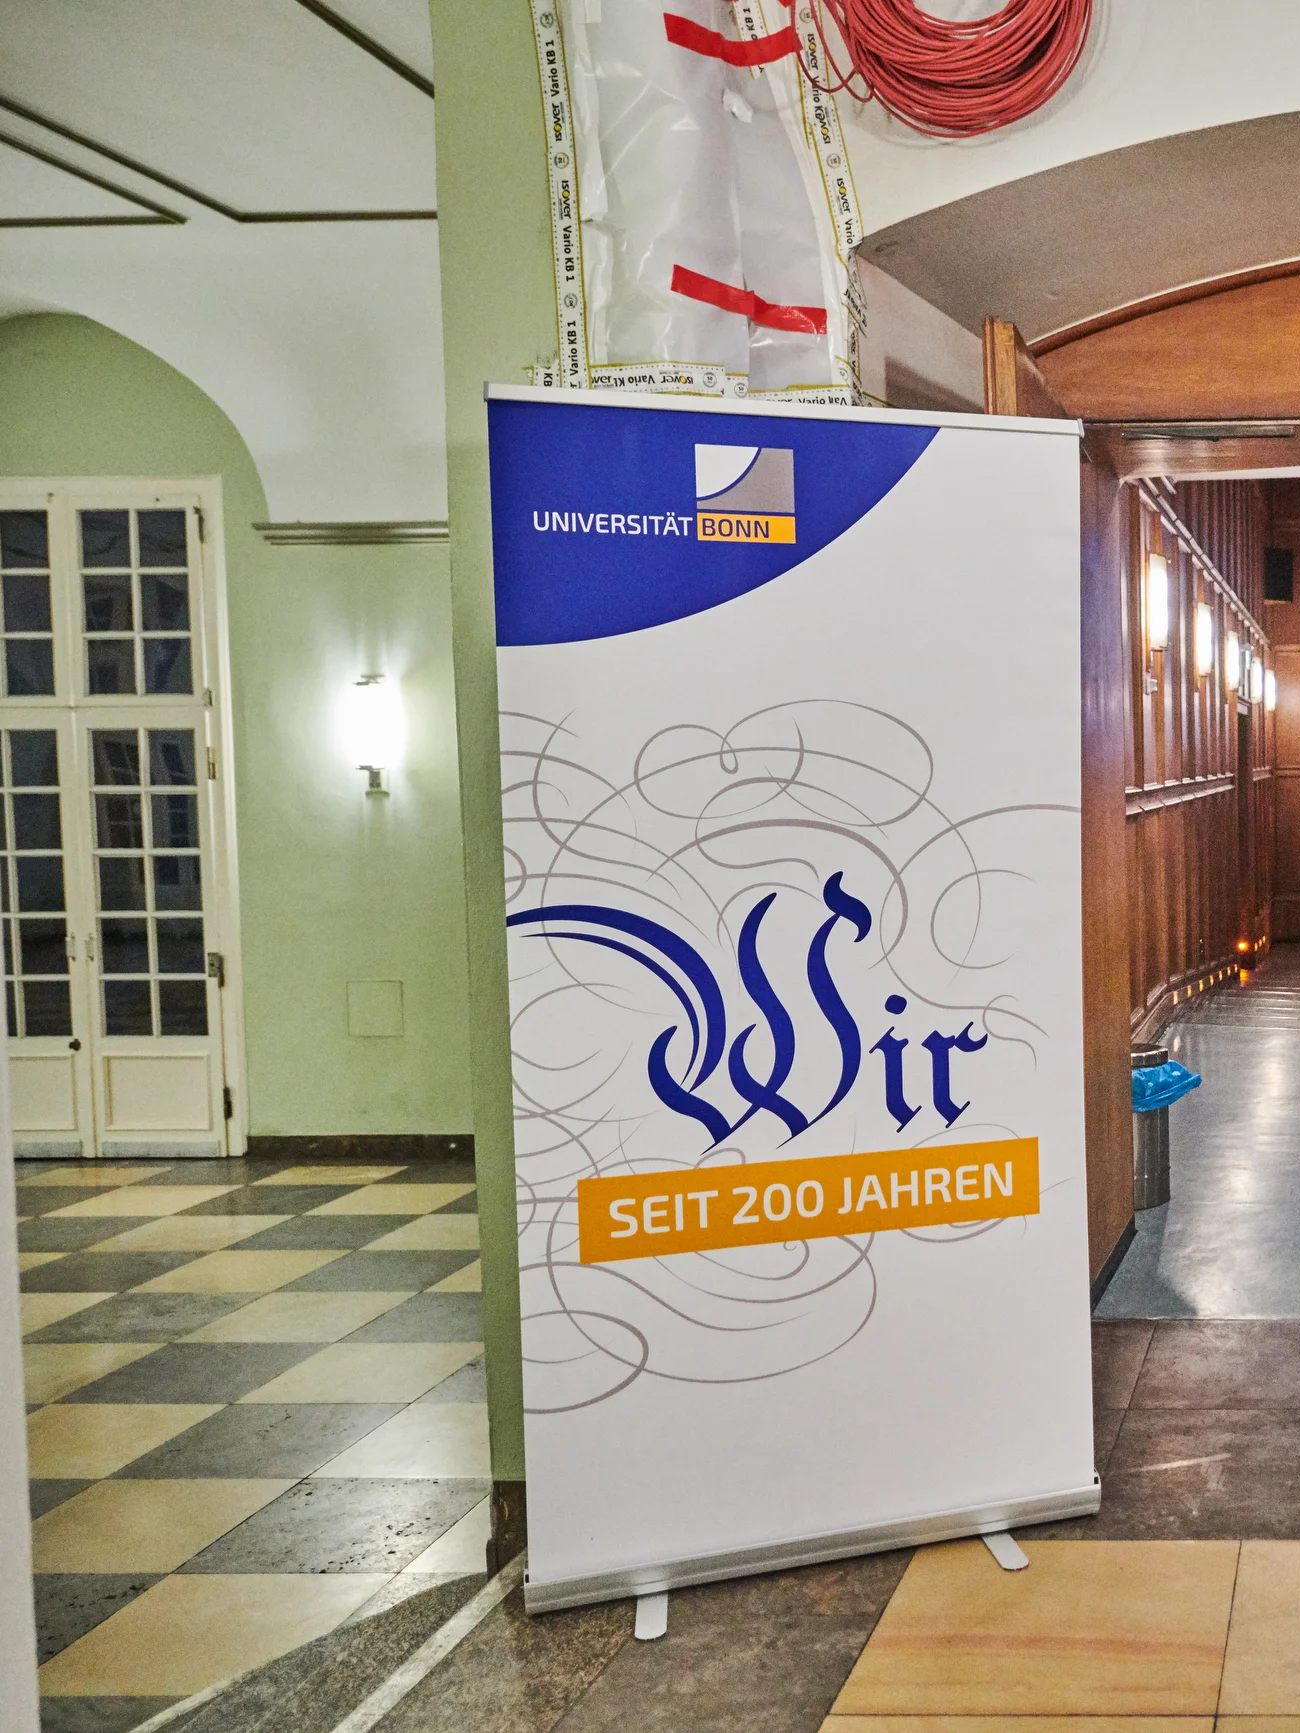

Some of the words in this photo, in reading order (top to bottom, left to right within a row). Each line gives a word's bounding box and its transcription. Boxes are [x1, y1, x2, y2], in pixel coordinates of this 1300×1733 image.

[545, 49, 556, 66] KB
[548, 68, 560, 97] Vario
[562, 225, 574, 255] Vario
[844, 218, 856, 245] Vario
[564, 257, 575, 273] KB
[567, 329, 577, 345] KB
[568, 347, 579, 376] Vario
[627, 374, 655, 385] Vario
[533, 510, 693, 537] UNIVERSITÄT
[702, 517, 771, 539] BONN
[506, 871, 988, 1155] Wir
[609, 1189, 719, 1239] SEIT
[732, 1179, 825, 1227] 200
[838, 1161, 1014, 1216] JAHREN
